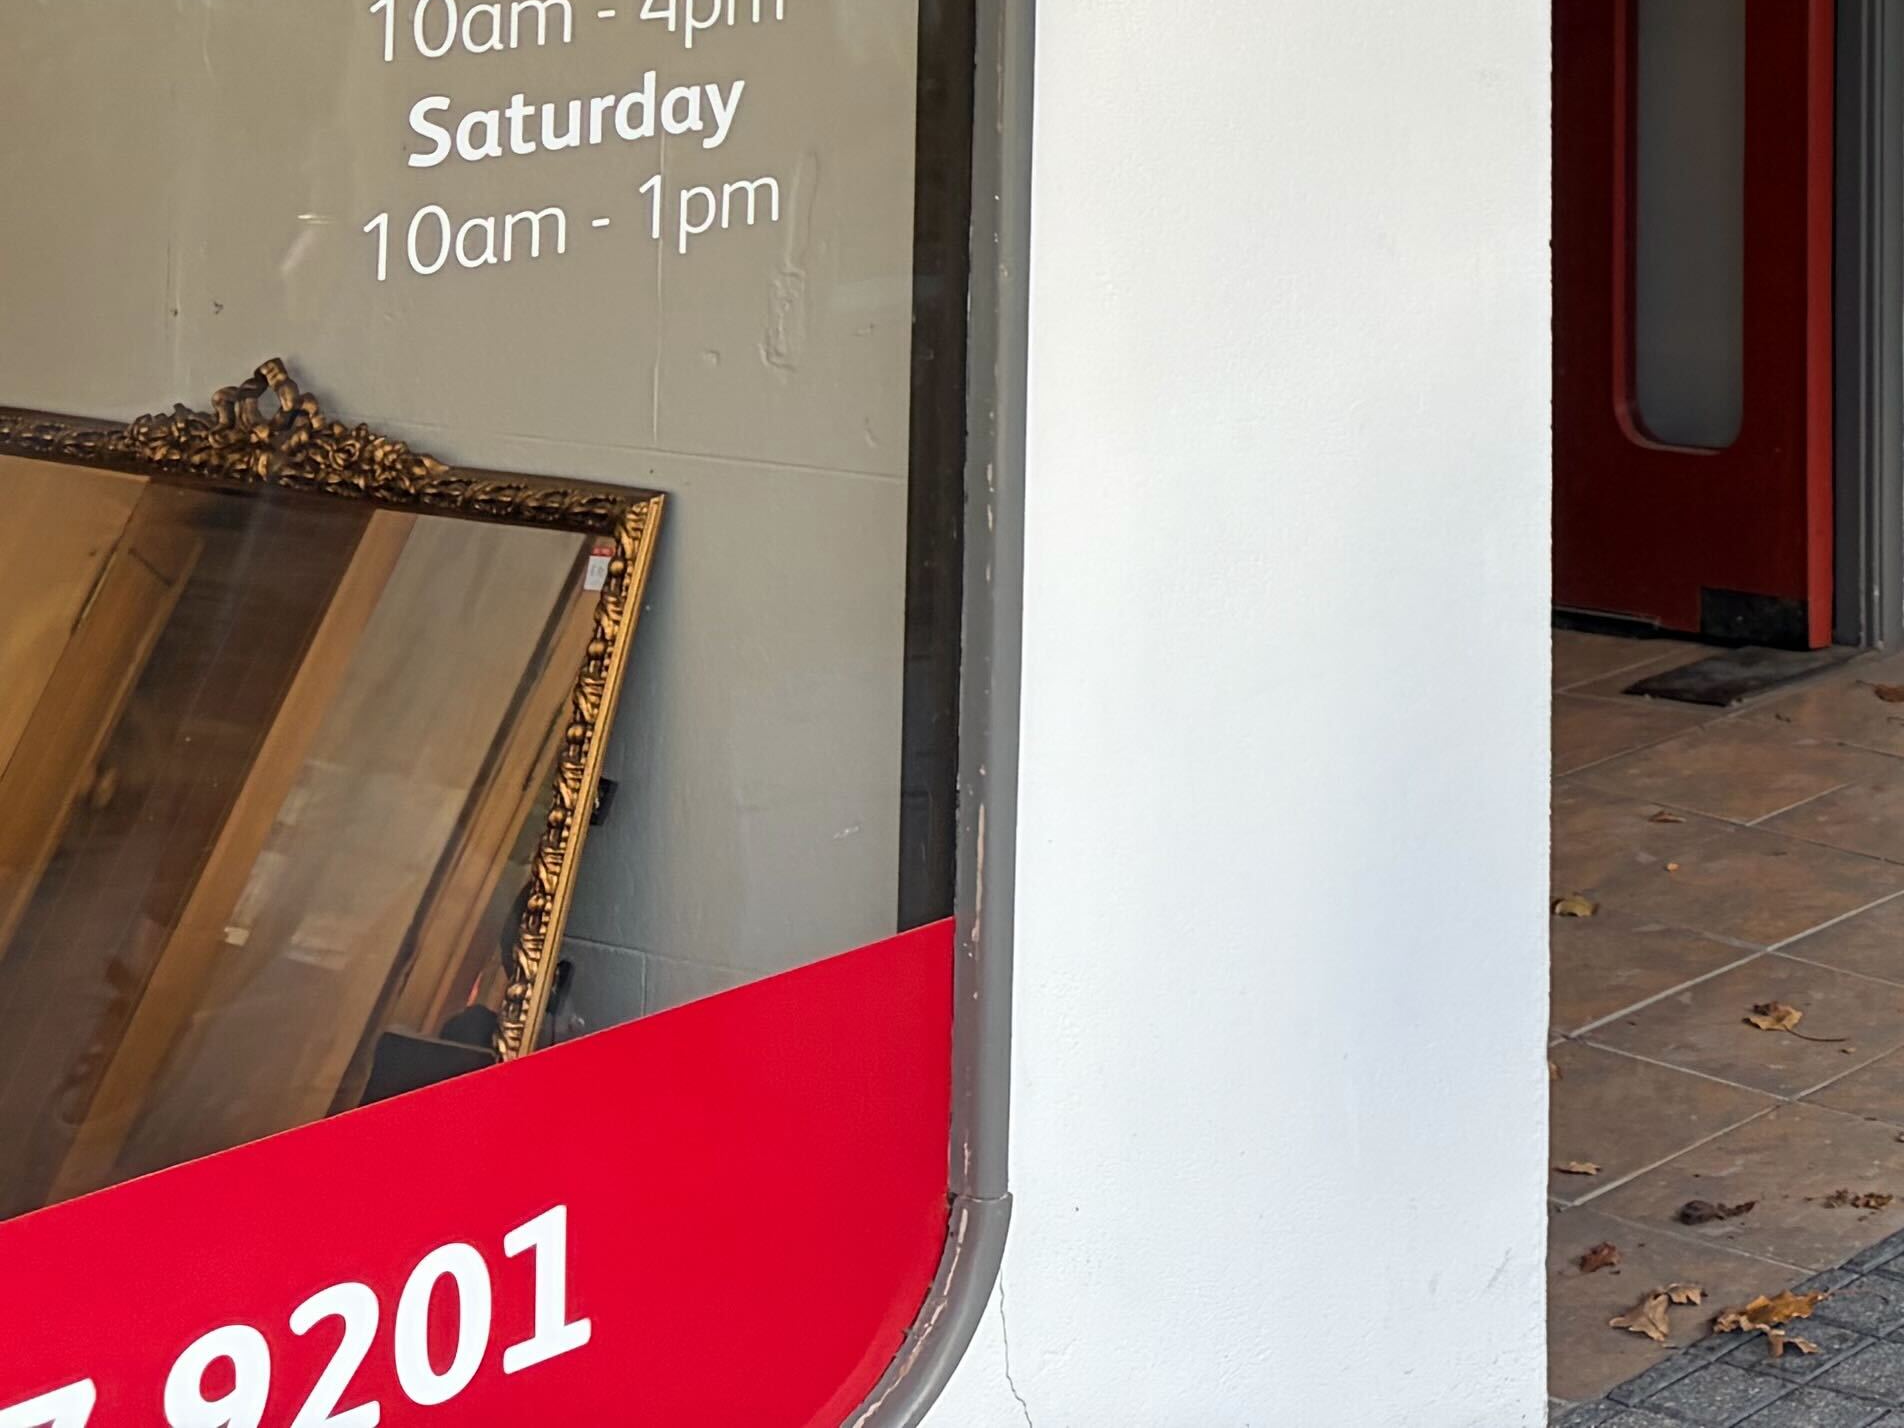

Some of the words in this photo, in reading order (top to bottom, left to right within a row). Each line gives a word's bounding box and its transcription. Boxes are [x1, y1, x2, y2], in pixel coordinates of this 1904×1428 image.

[408, 70, 745, 167] Saturday
[363, 205, 566, 281] 10am
[639, 174, 779, 254] 1pm
[164, 1204, 591, 1428] 9201
